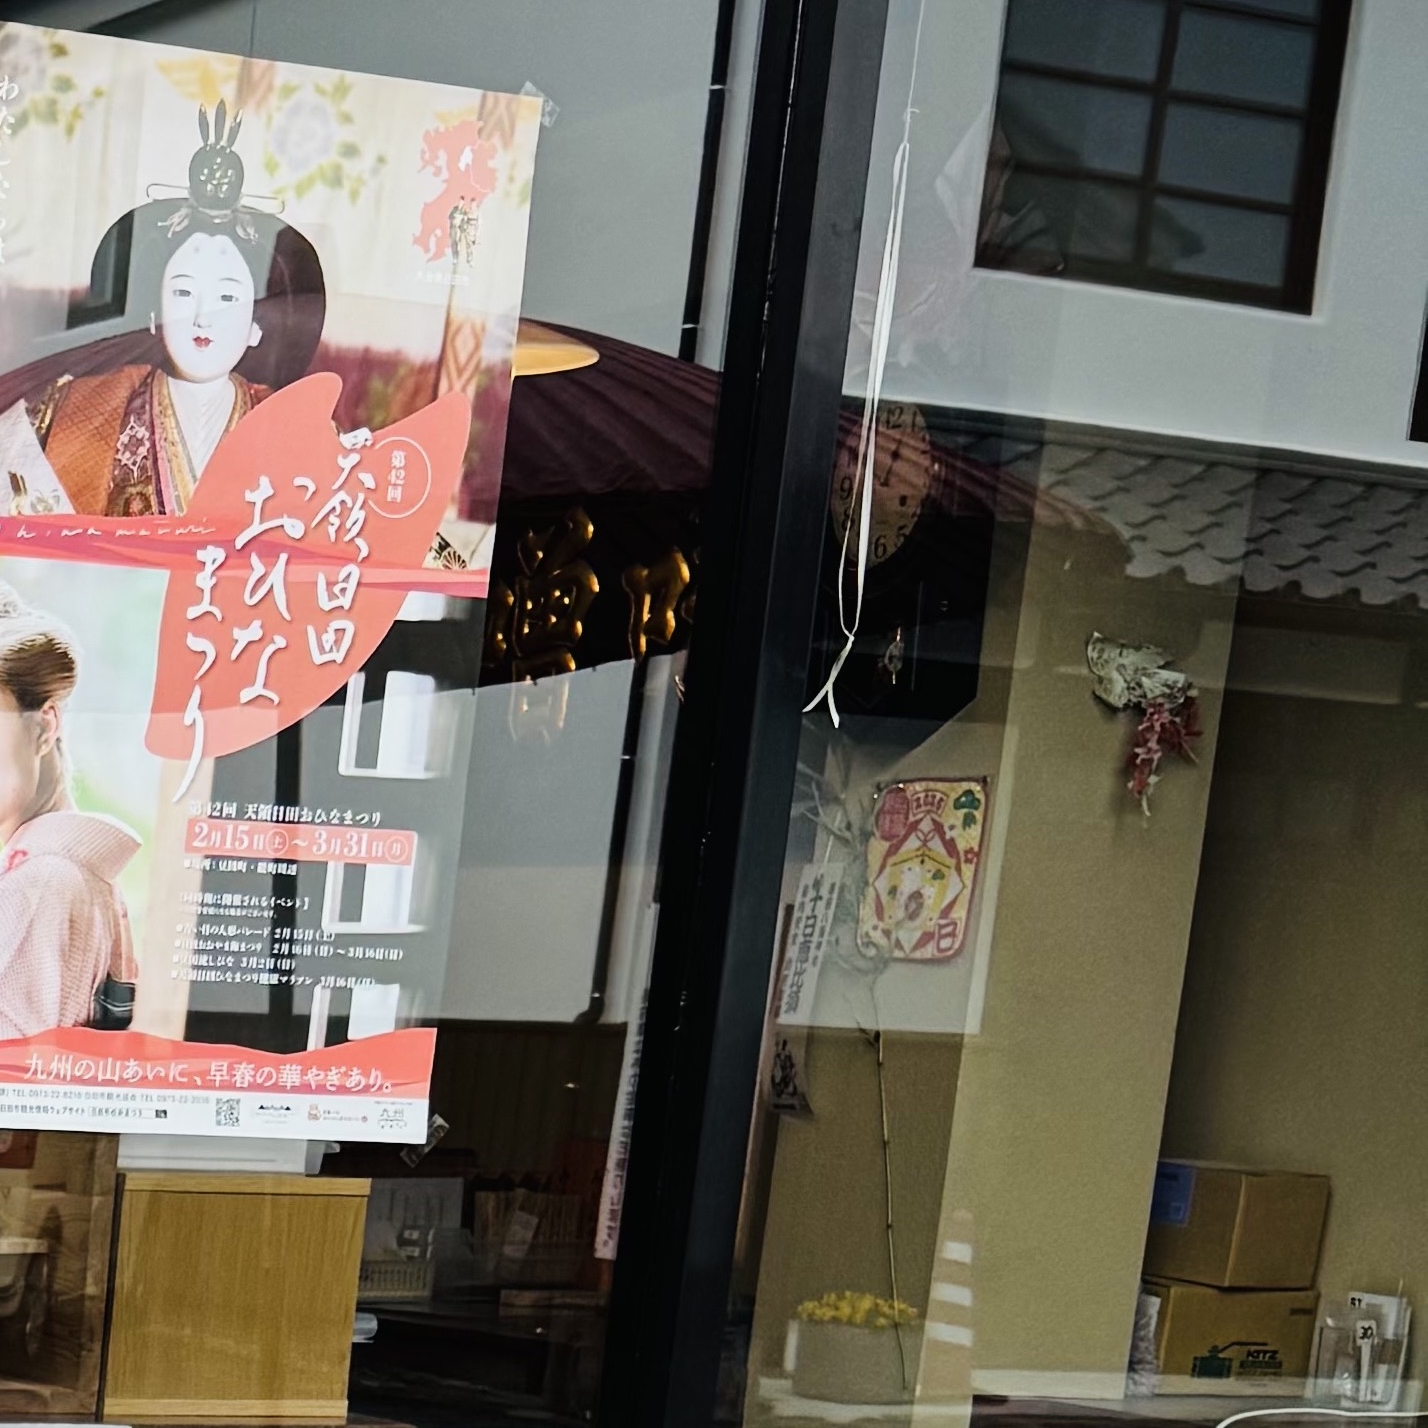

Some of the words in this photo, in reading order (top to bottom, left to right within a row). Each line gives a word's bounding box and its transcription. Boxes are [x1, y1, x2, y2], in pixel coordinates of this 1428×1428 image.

[386, 449, 407, 503] 第42回
[23, 1052, 392, 1094] 九州の山あいに、早春の華やぎあり。
